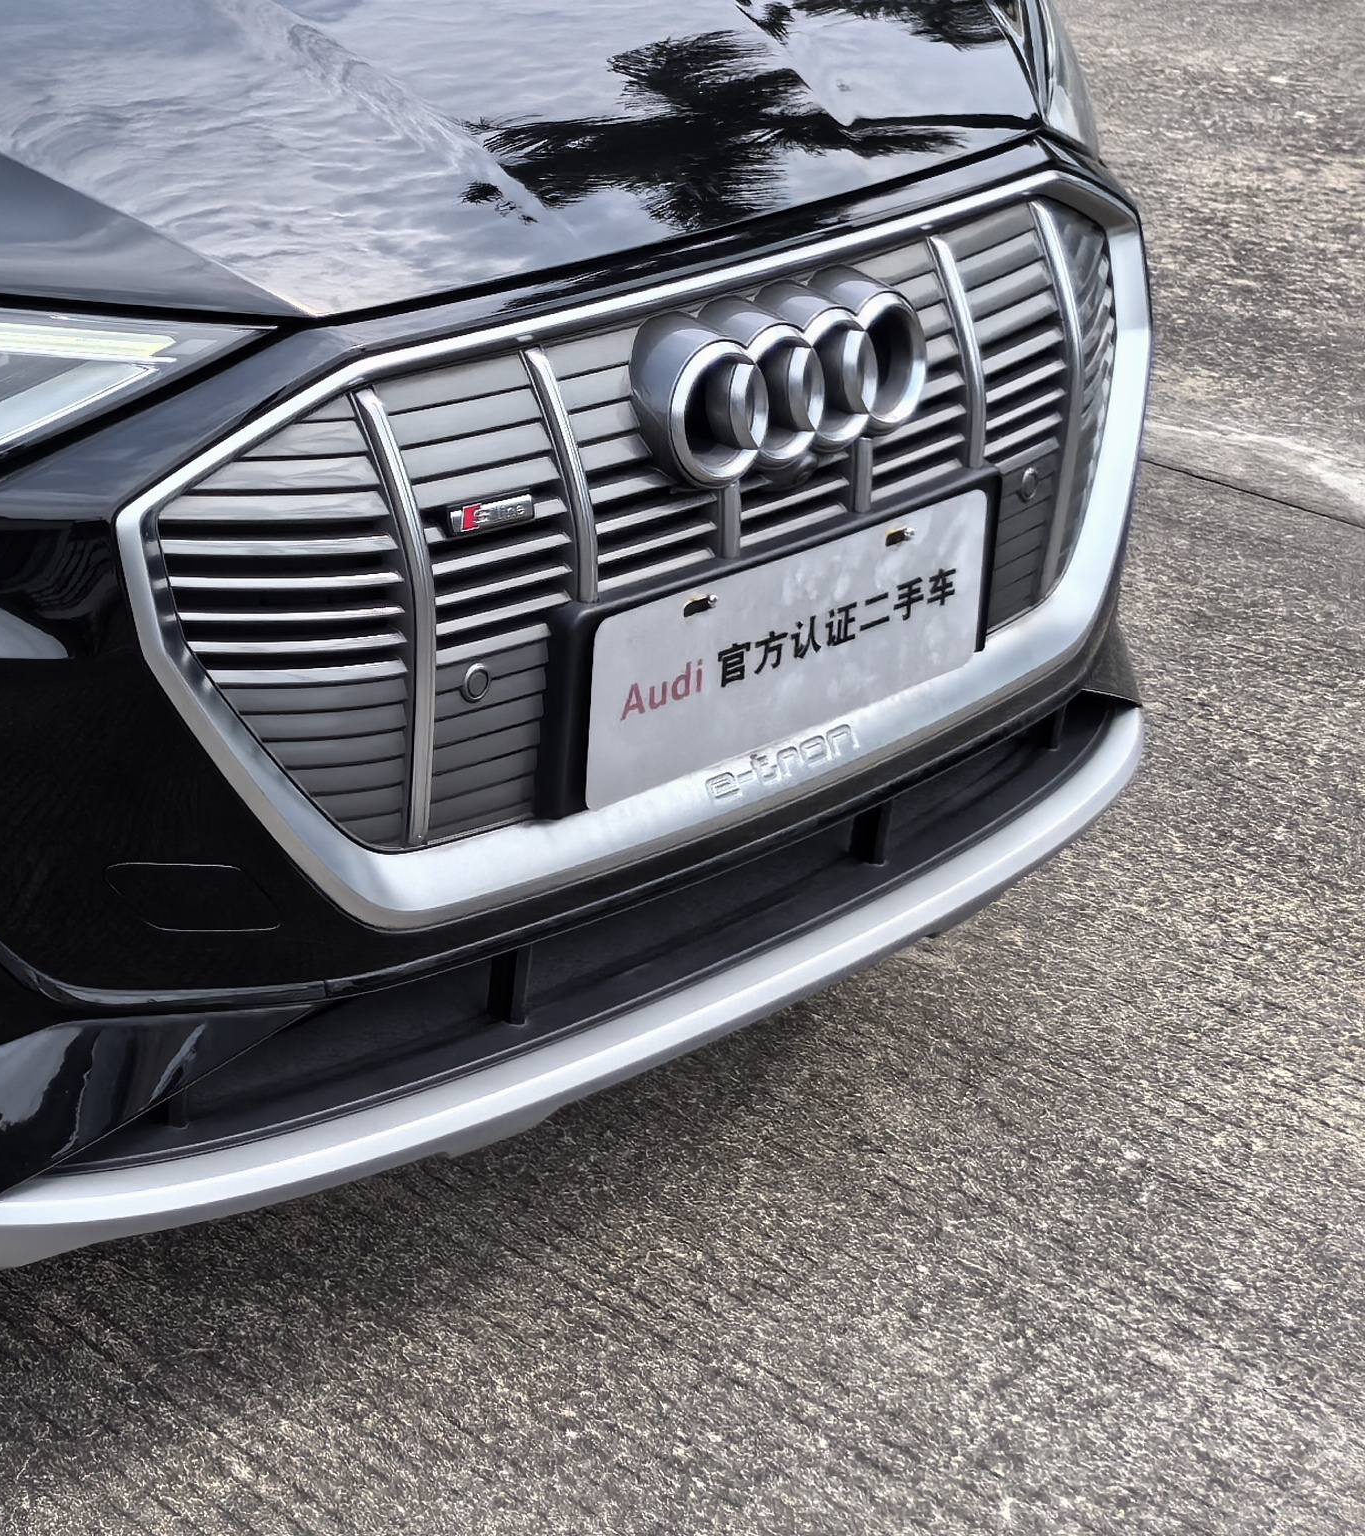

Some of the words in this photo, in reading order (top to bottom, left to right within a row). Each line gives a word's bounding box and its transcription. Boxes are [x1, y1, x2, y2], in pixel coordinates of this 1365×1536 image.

[620, 659, 703, 721] Audi
[718, 568, 957, 688] 官方认证二手车
[705, 723, 859, 800] e-tron
